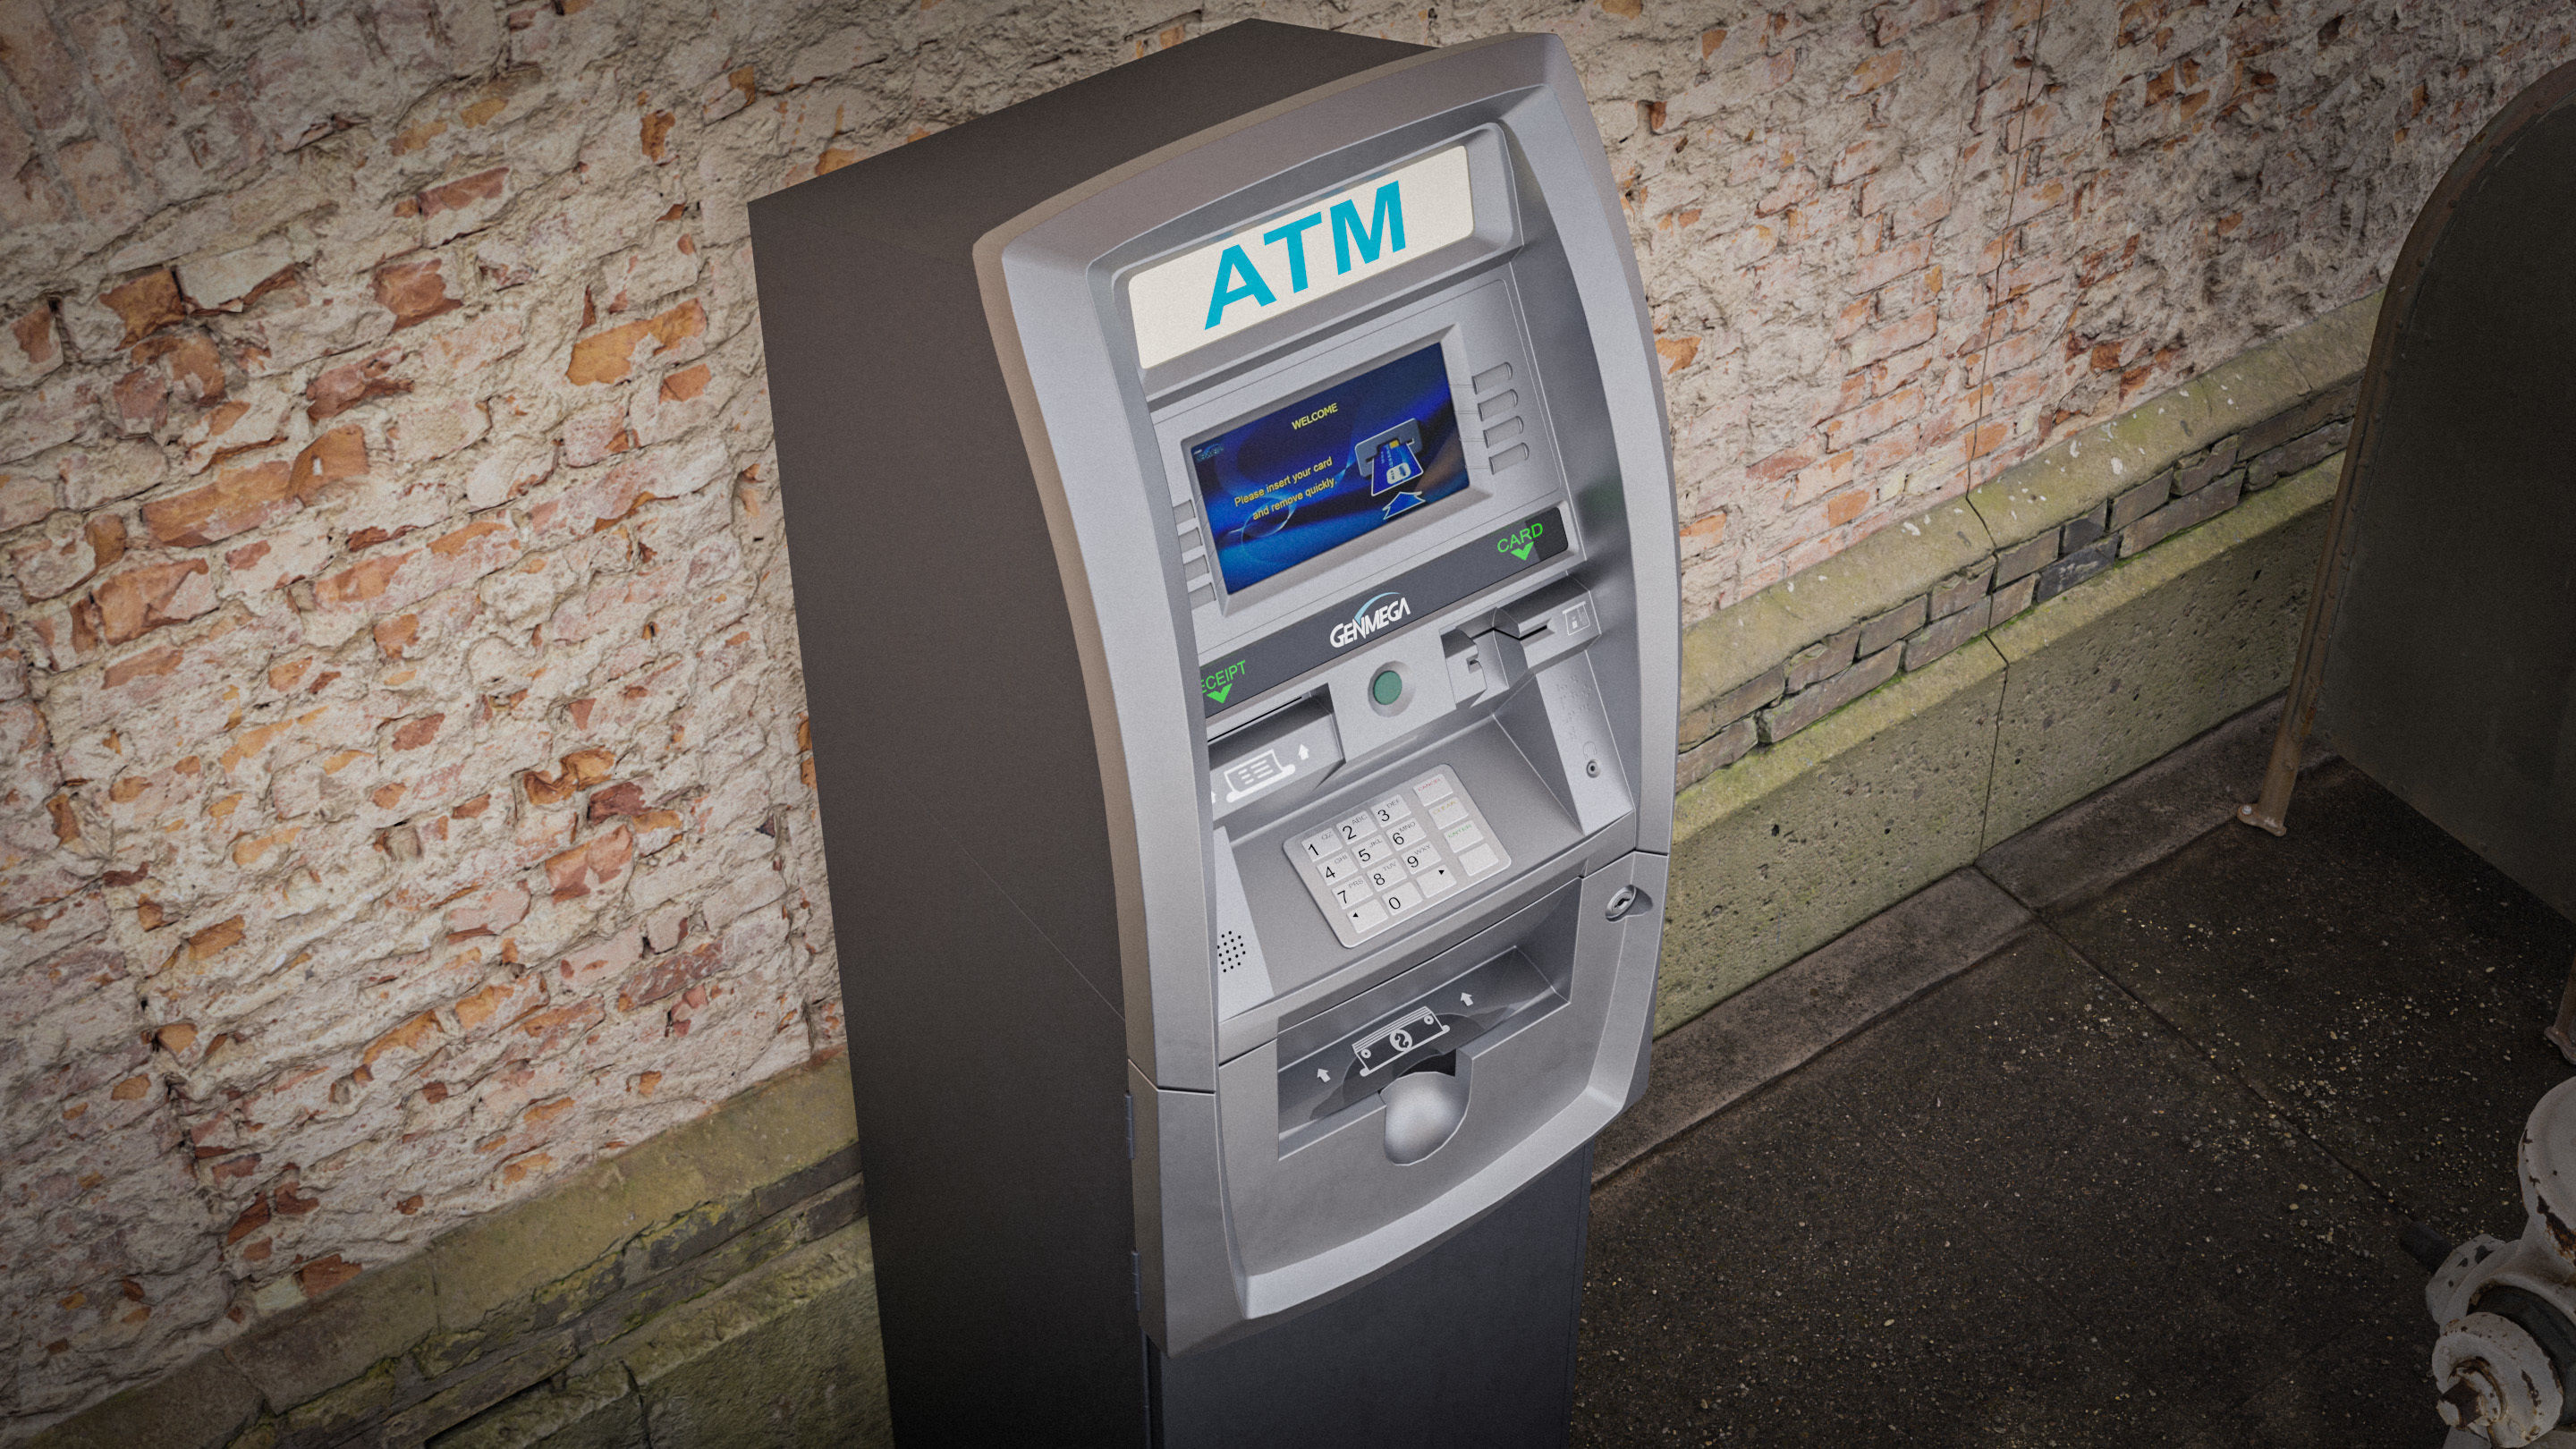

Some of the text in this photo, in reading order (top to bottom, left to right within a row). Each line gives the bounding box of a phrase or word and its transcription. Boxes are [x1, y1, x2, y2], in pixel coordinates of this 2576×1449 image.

[1204, 180, 1406, 331] ATM
[1292, 402, 1339, 430] WELCOME
[1234, 456, 1333, 507] Please insert your card
[1252, 478, 1337, 521] and remove quickly.
[1497, 522, 1543, 553] CARD
[1329, 597, 1411, 648] GENMEGA
[1377, 809, 1390, 822] 3
[1343, 825, 1357, 841] 2
[1393, 832, 1404, 845] 6
[1308, 843, 1319, 856] 1
[1358, 848, 1371, 862] 5
[1407, 843, 1431, 868] 9 WXY
[1326, 866, 1335, 878] 4
[1373, 873, 1385, 886] 8
[1336, 890, 1347, 904] 7
[1388, 896, 1402, 910] 0
